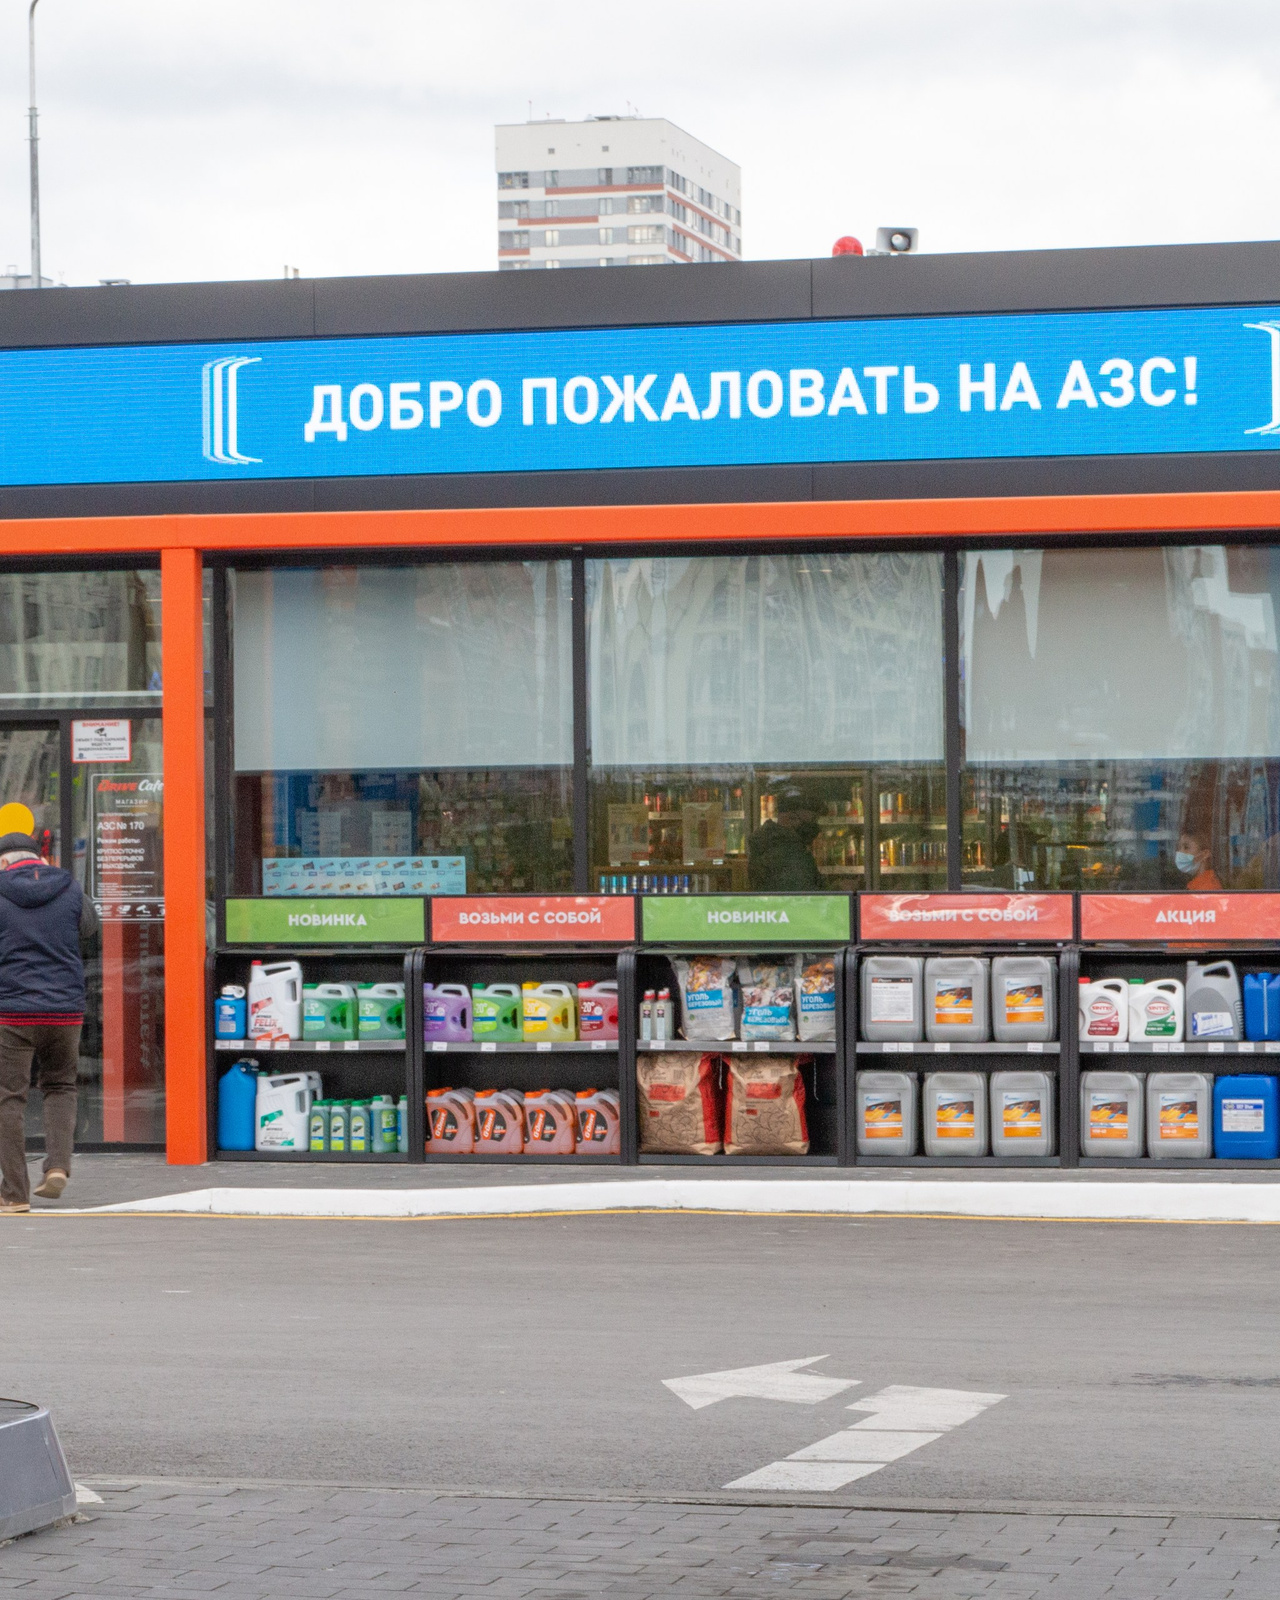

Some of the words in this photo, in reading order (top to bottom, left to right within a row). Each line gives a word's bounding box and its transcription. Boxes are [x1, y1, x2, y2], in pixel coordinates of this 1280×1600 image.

[304, 379, 503, 443] ДОБРО
[522, 366, 940, 426] ПОЖАЛОВАТЬ
[959, 361, 1042, 413] НА
[1056, 356, 1198, 409] АЗС!
[97, 821, 116, 830] АЗС
[129, 821, 145, 830] 170
[287, 914, 368, 927] НОВИНКА
[458, 912, 524, 925] ВОЗЬМИ
[527, 912, 540, 924] С
[543, 907, 601, 924] СОБОЙ
[706, 910, 790, 924] НОВИНКА
[888, 909, 958, 923] ВОЗЬМИ
[961, 909, 975, 923] С
[977, 905, 1039, 923] СОБОЙ
[1154, 909, 1217, 926] АКЦИЯ
[687, 993, 710, 1002] УГОЛЬ
[801, 995, 824, 1003] УГОЛЬ
